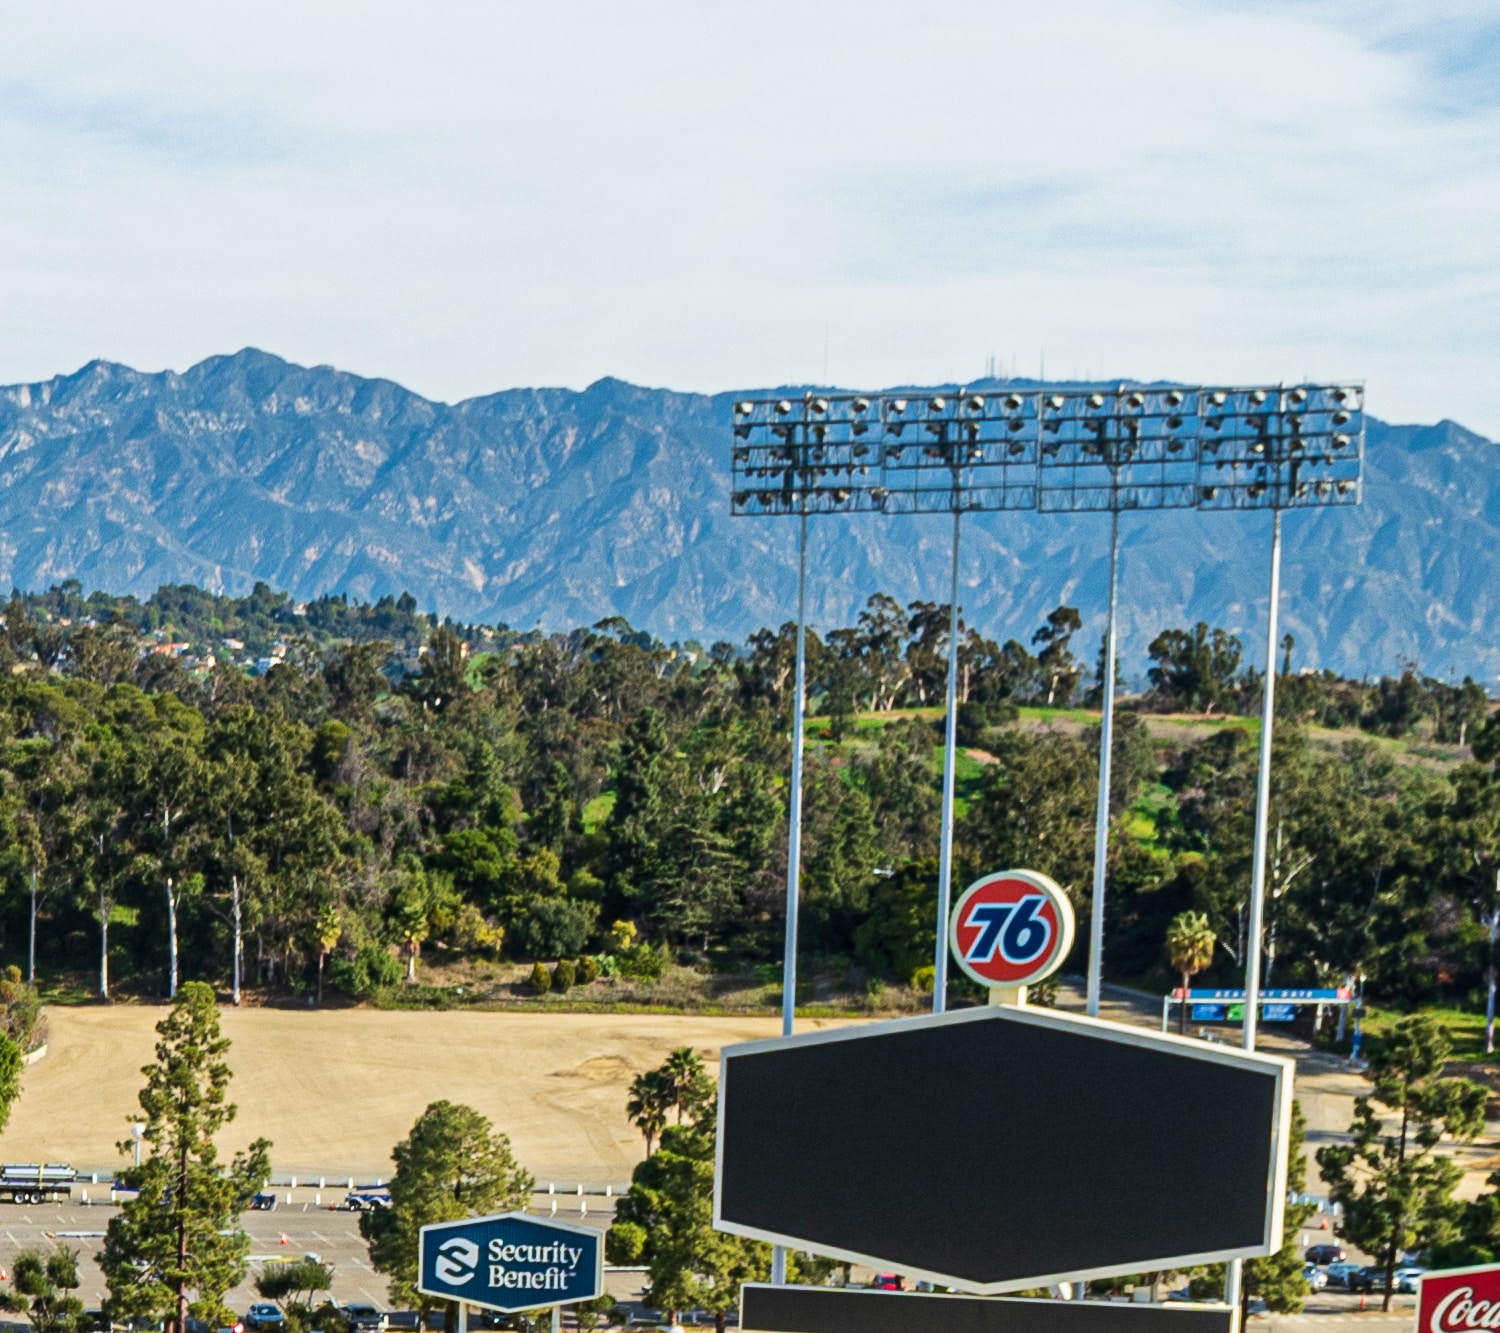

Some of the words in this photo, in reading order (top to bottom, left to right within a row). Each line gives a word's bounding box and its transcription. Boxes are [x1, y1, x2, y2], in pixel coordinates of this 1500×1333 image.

[968, 896, 1048, 963] 76
[487, 1238, 583, 1269] Security
[487, 1265, 569, 1290] Benefit
